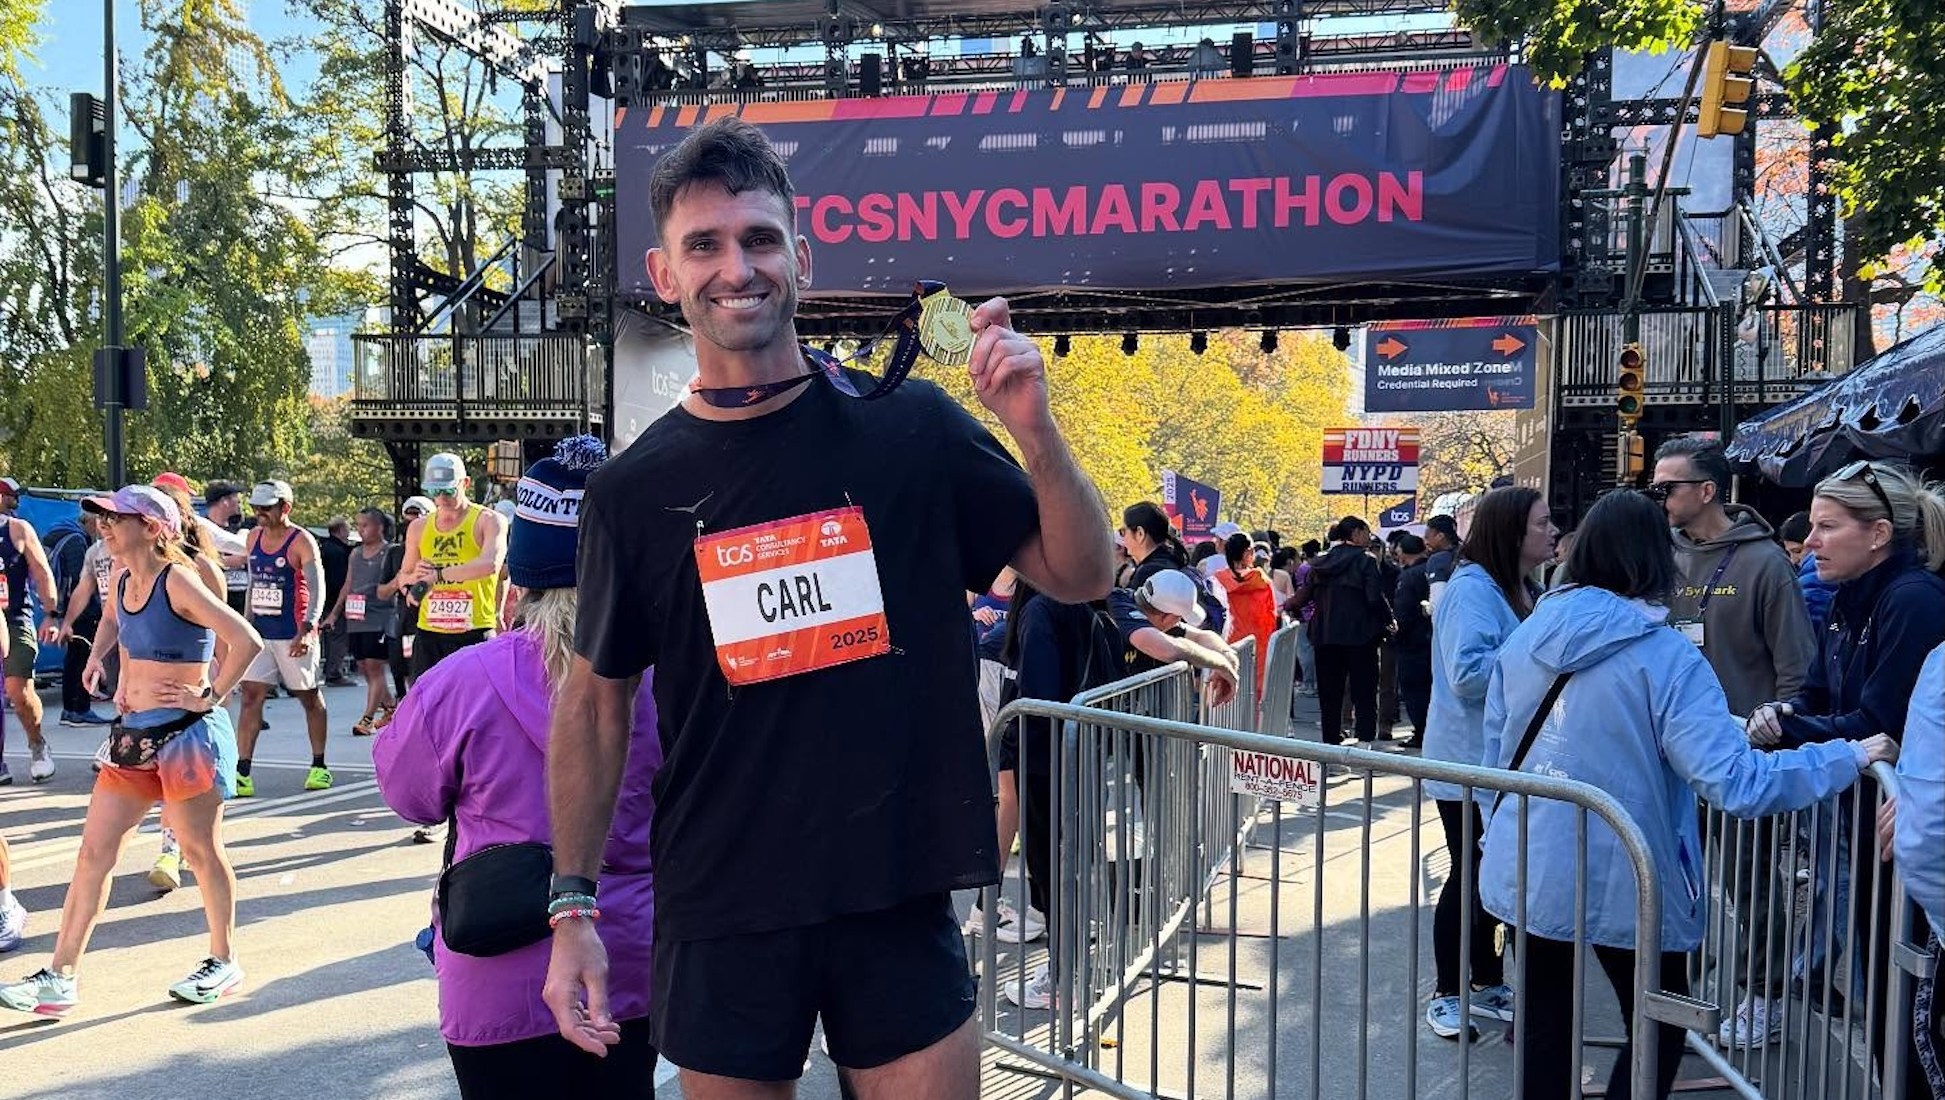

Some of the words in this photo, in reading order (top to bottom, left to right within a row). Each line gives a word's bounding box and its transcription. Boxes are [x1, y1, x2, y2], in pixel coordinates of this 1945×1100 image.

[1378, 363, 1422, 377] Media
[1426, 362, 1470, 375] Mixed
[1473, 361, 1512, 374] Zone
[1377, 379, 1430, 390] Credential
[1431, 377, 1478, 390] Required
[1344, 429, 1399, 449] FDNY
[1343, 449, 1399, 462] RUNNERS
[1341, 464, 1403, 481] NYPD
[1341, 482, 1397, 492] RUNNERS
[518, 486, 583, 515] OLUNT
[754, 534, 777, 544] TATA
[755, 536, 807, 552] CONSULTANCY
[820, 535, 848, 548] TATA
[717, 543, 754, 567] tcs
[757, 547, 791, 560] SERVICES
[757, 572, 832, 623] CARL
[431, 600, 470, 614] 24927
[830, 626, 879, 650] 2025
[1234, 750, 1317, 785] NATIONAL
